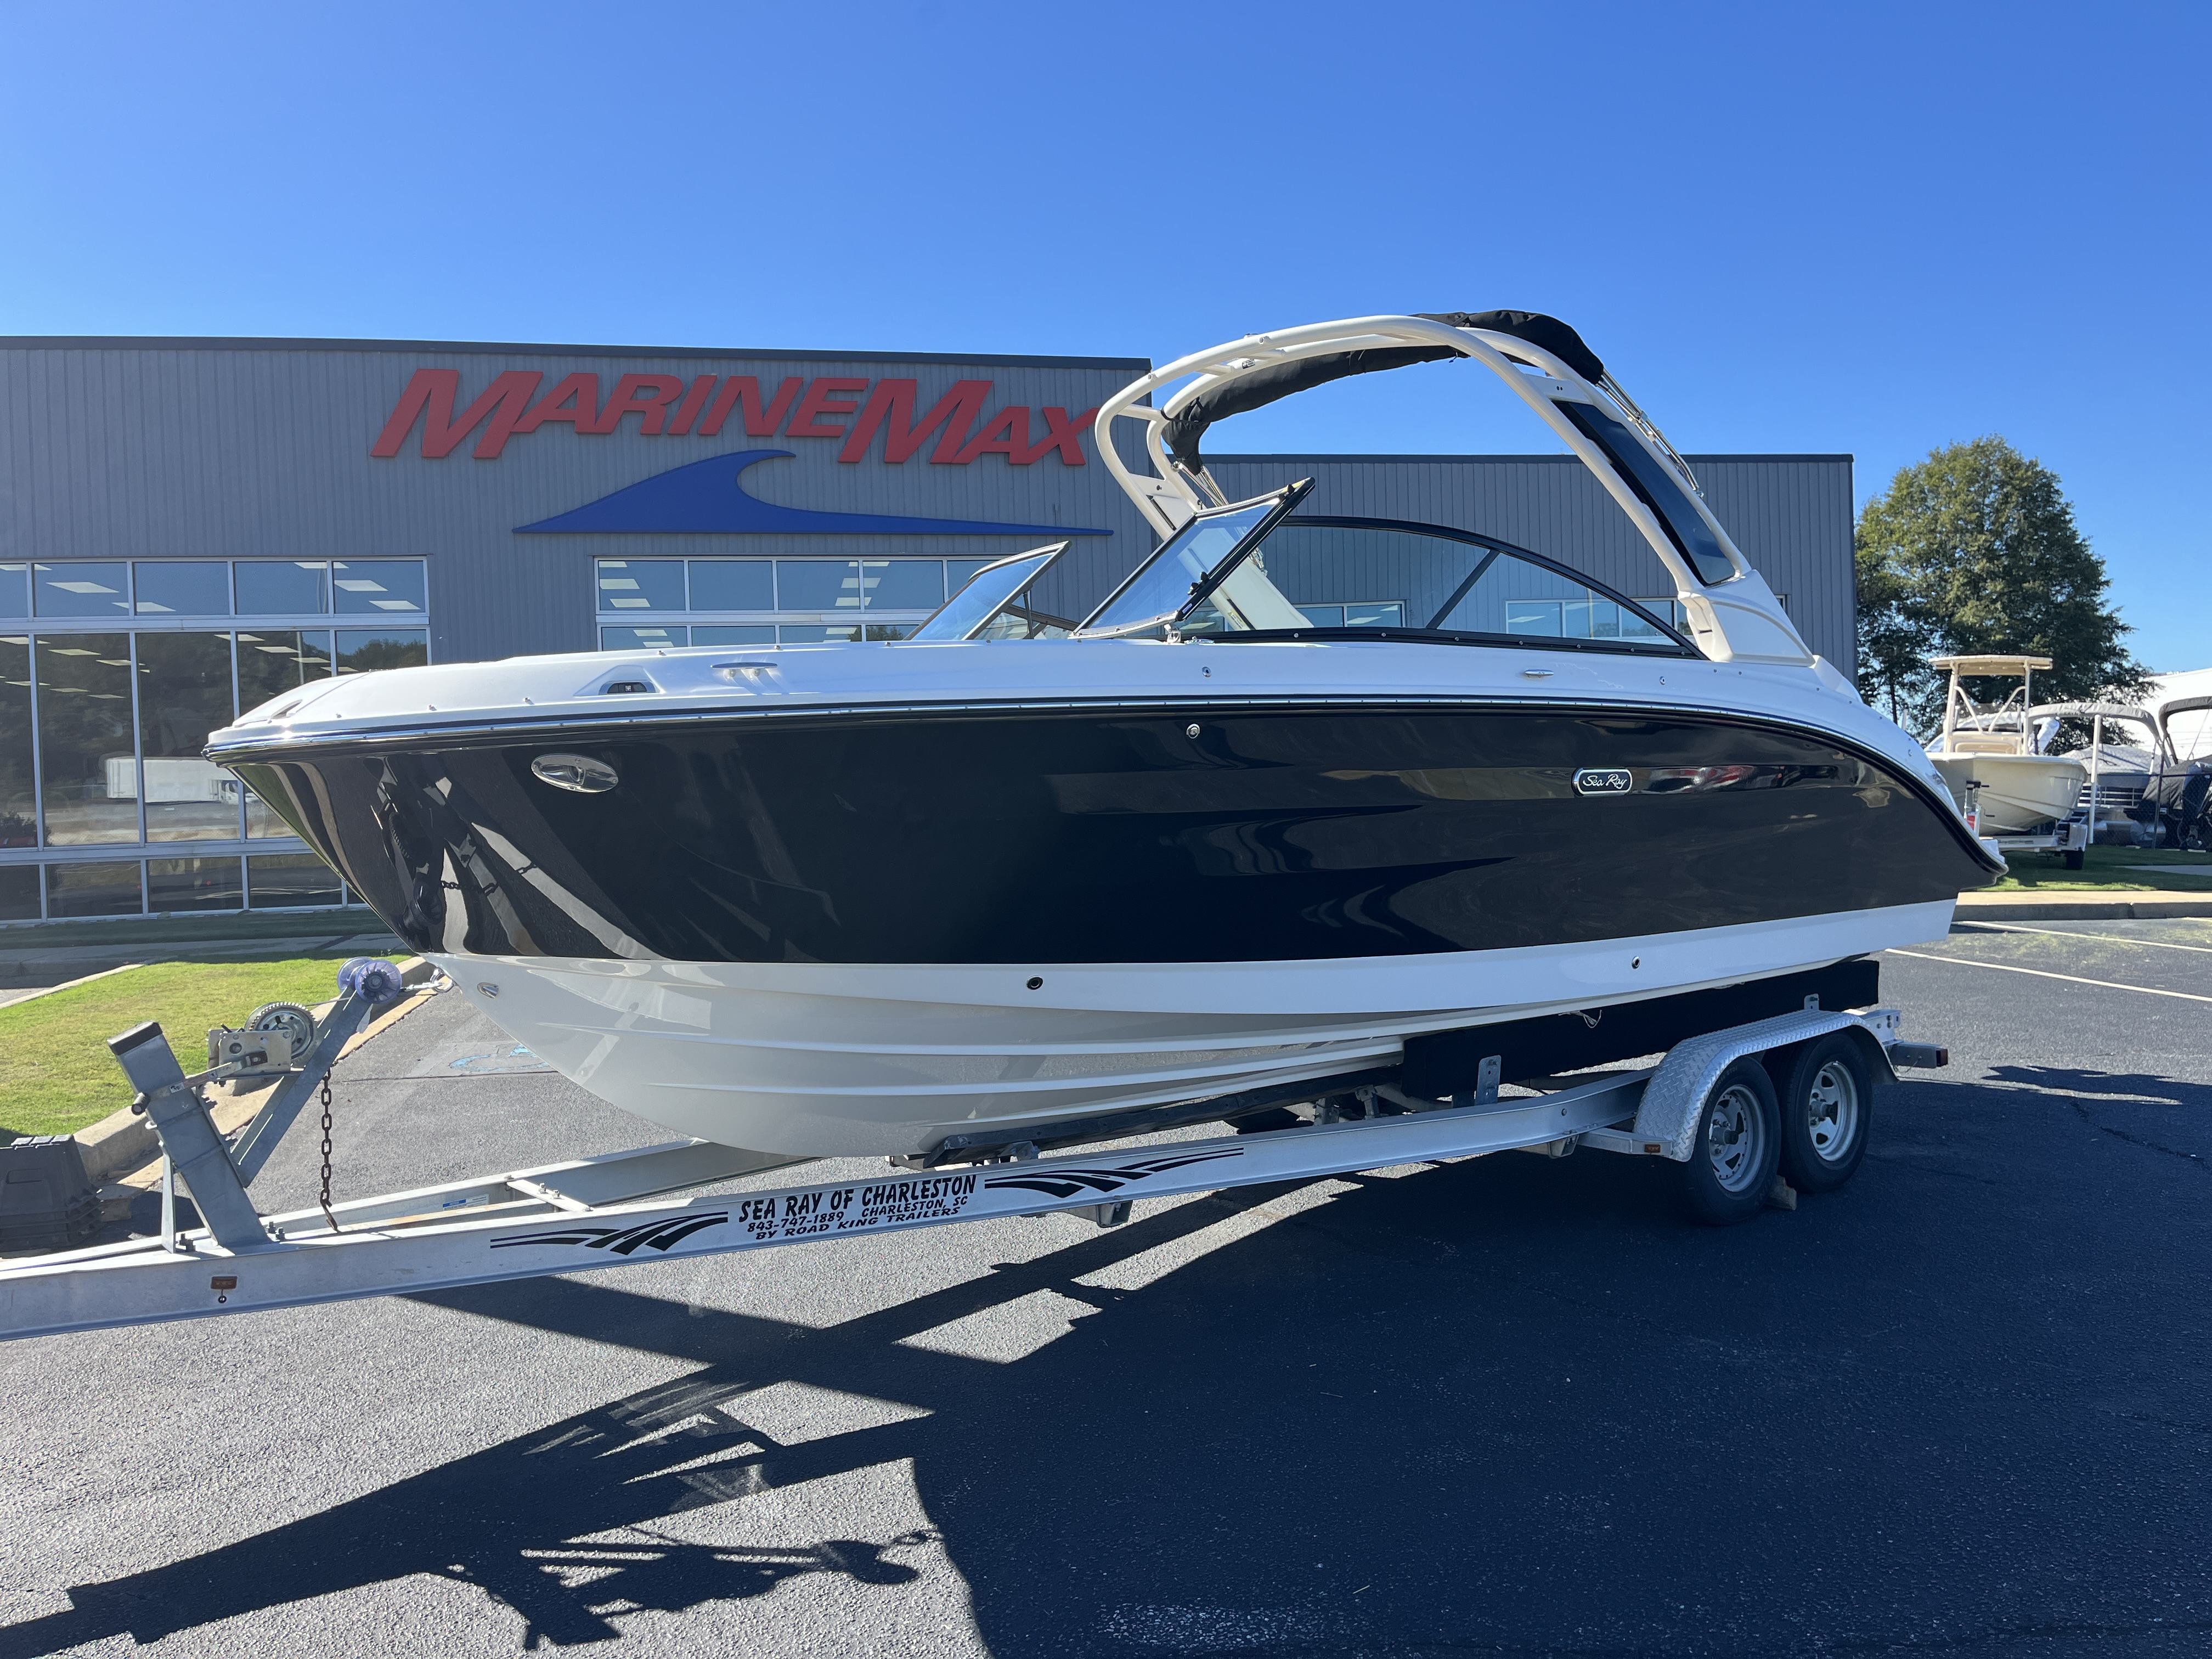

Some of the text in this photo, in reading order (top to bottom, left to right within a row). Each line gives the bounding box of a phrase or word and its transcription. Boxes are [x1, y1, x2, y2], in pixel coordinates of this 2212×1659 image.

[1582, 774, 1628, 789] Sea Ray
[739, 1174, 977, 1223] SEA RAY OF CHARLESTON
[747, 1195, 968, 1232] 843-747-1889 CHARLESTON, SC
[755, 1206, 961, 1240] BY ROAD KING TRAILERS
